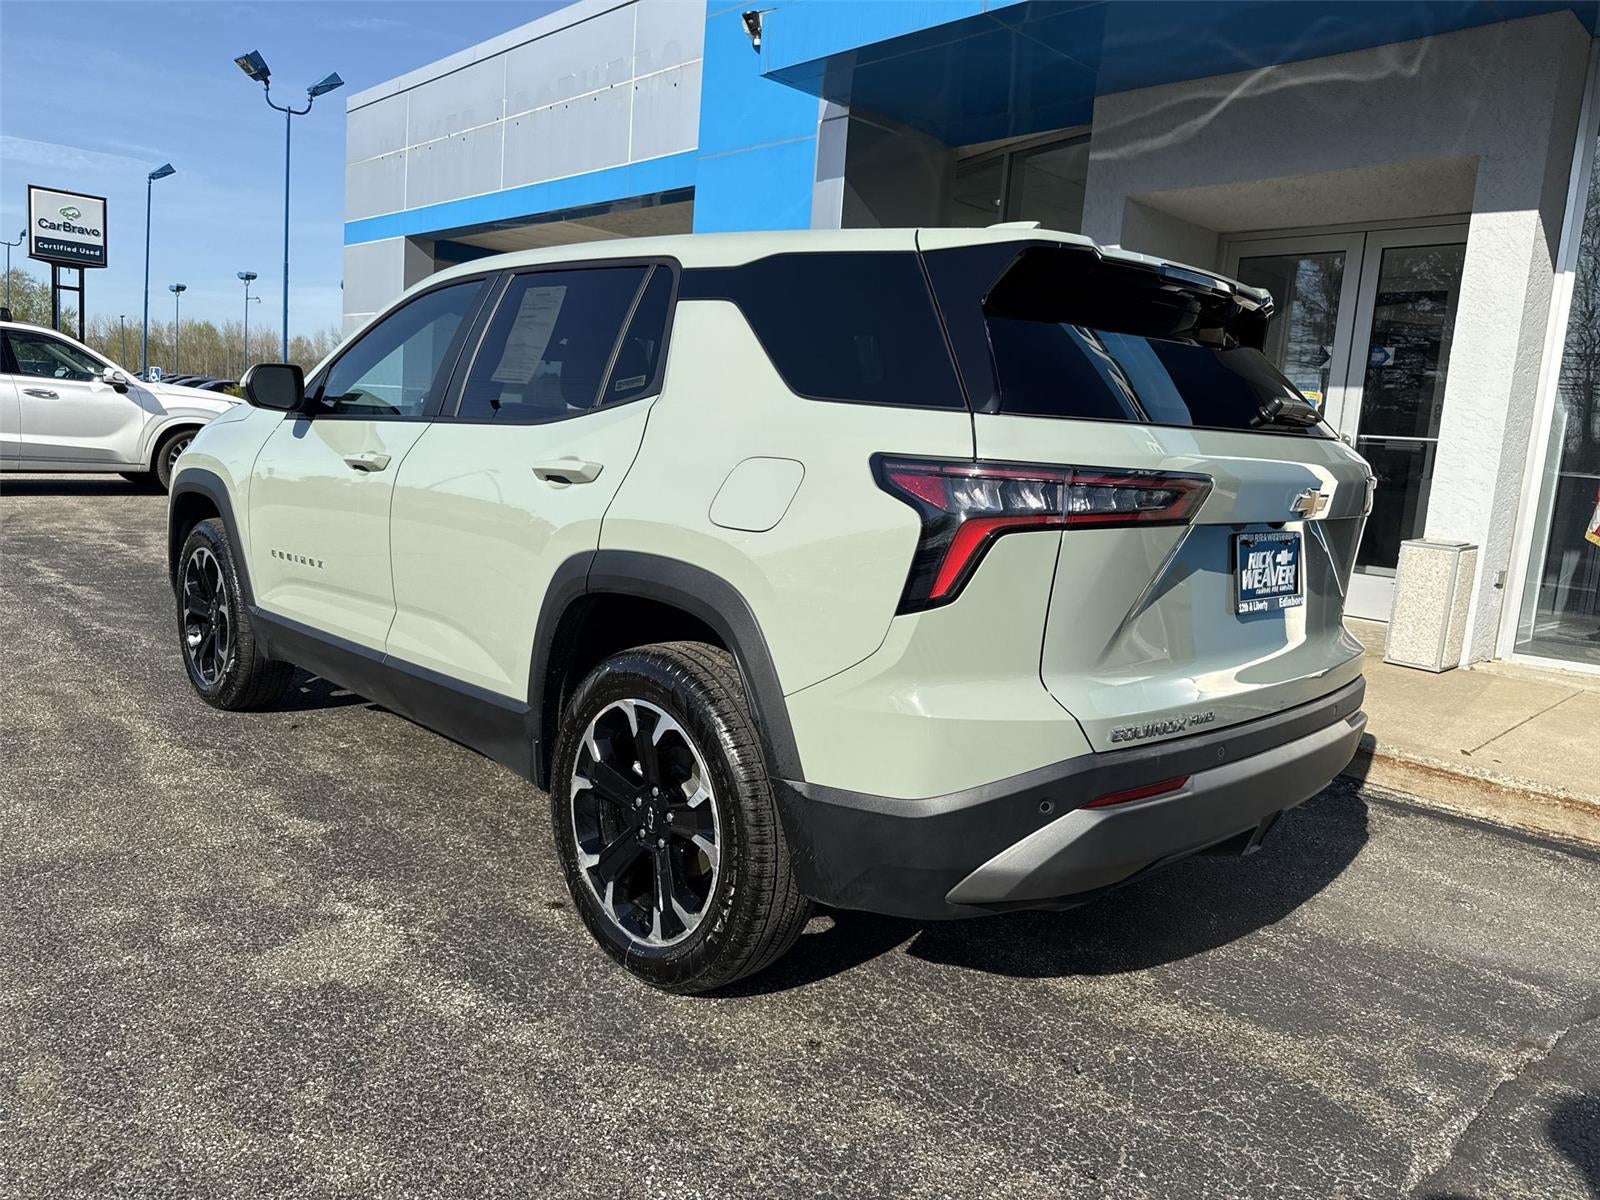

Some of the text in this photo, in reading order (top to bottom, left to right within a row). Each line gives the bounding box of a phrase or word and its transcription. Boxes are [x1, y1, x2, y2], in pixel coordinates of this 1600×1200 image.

[38, 217, 101, 237] CarBravo
[38, 241, 100, 256] Certified Used
[271, 549, 324, 569] EQUINOX
[1247, 550, 1275, 570] RICK
[1242, 564, 1296, 590] WEAVER
[1111, 718, 1187, 742] EQUINOX
